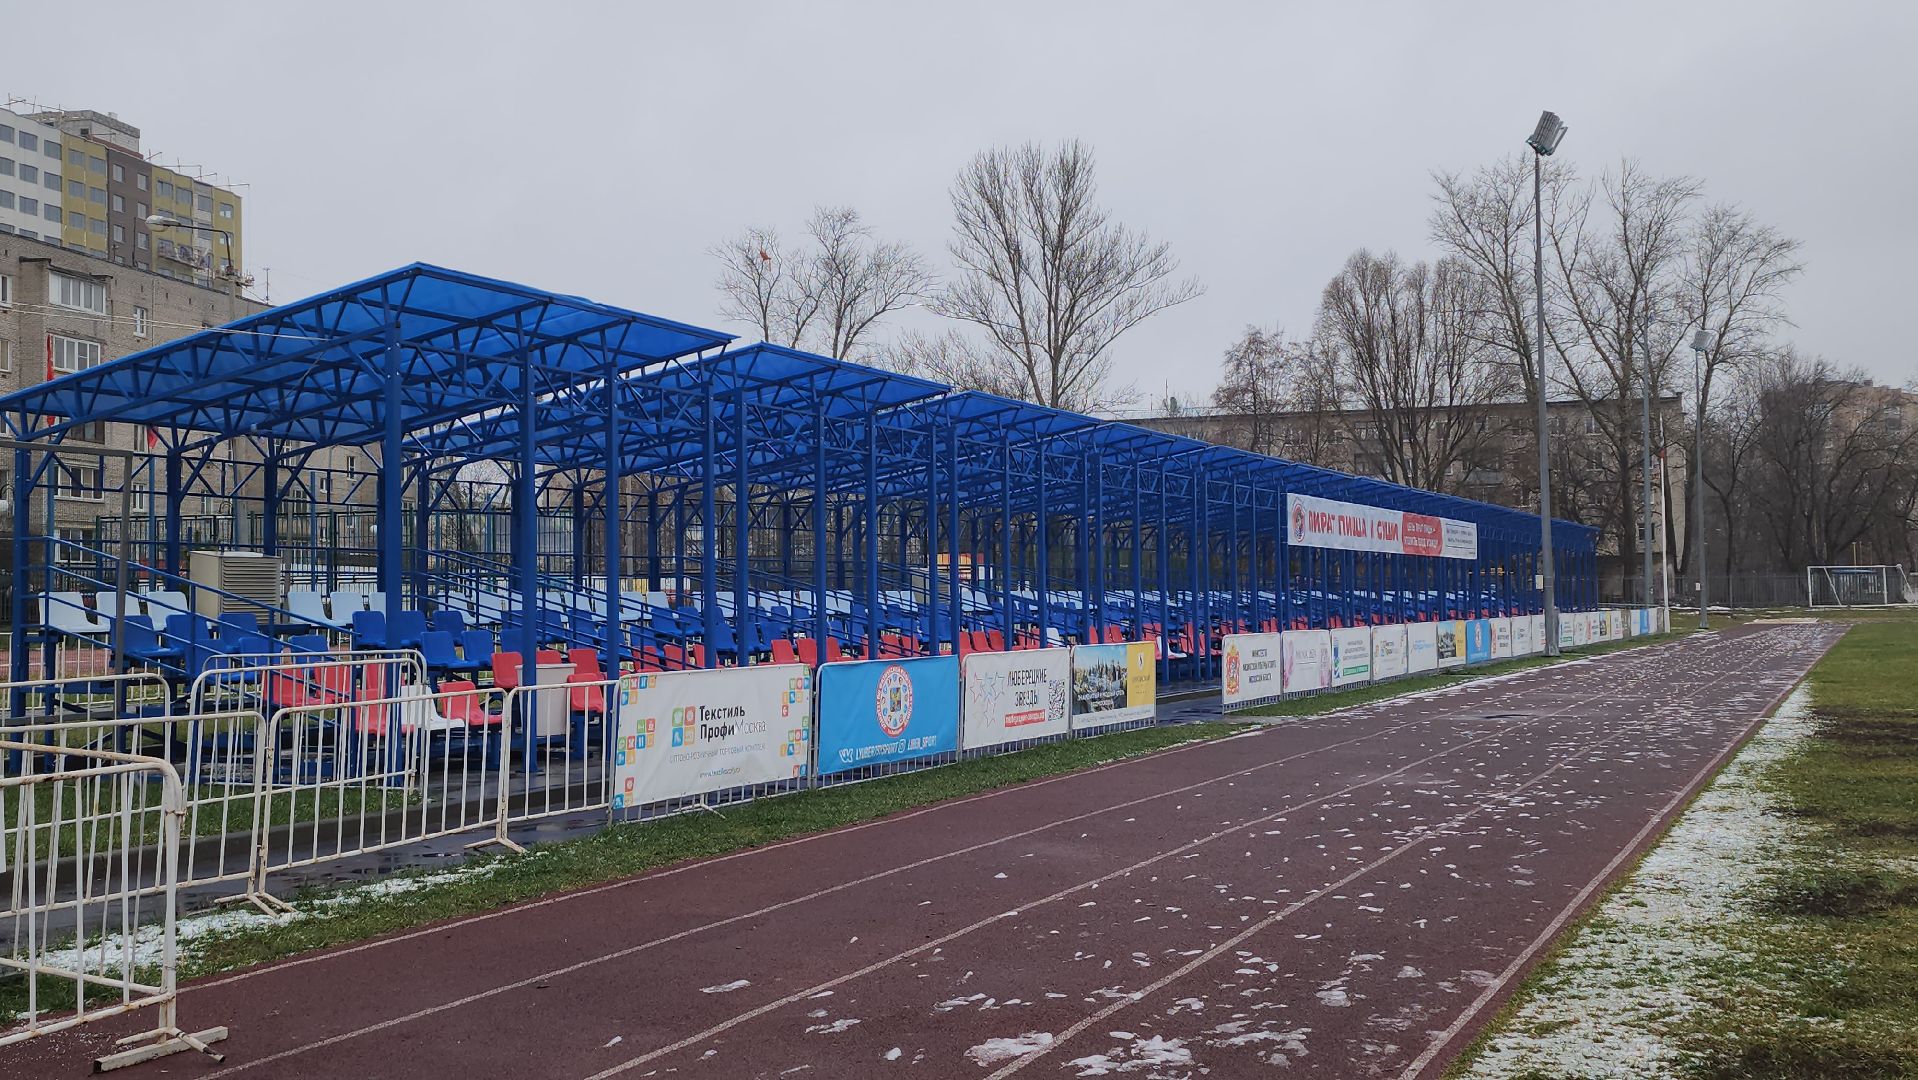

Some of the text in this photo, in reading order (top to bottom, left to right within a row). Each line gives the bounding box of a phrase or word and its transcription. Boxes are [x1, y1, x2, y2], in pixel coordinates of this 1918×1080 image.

[1308, 510, 1336, 533] ПИРАТ
[1377, 521, 1399, 541] СУШИ
[1007, 669, 1047, 687] ЛЮБЕРЕЦКИЕ
[699, 705, 746, 721] Текстиль
